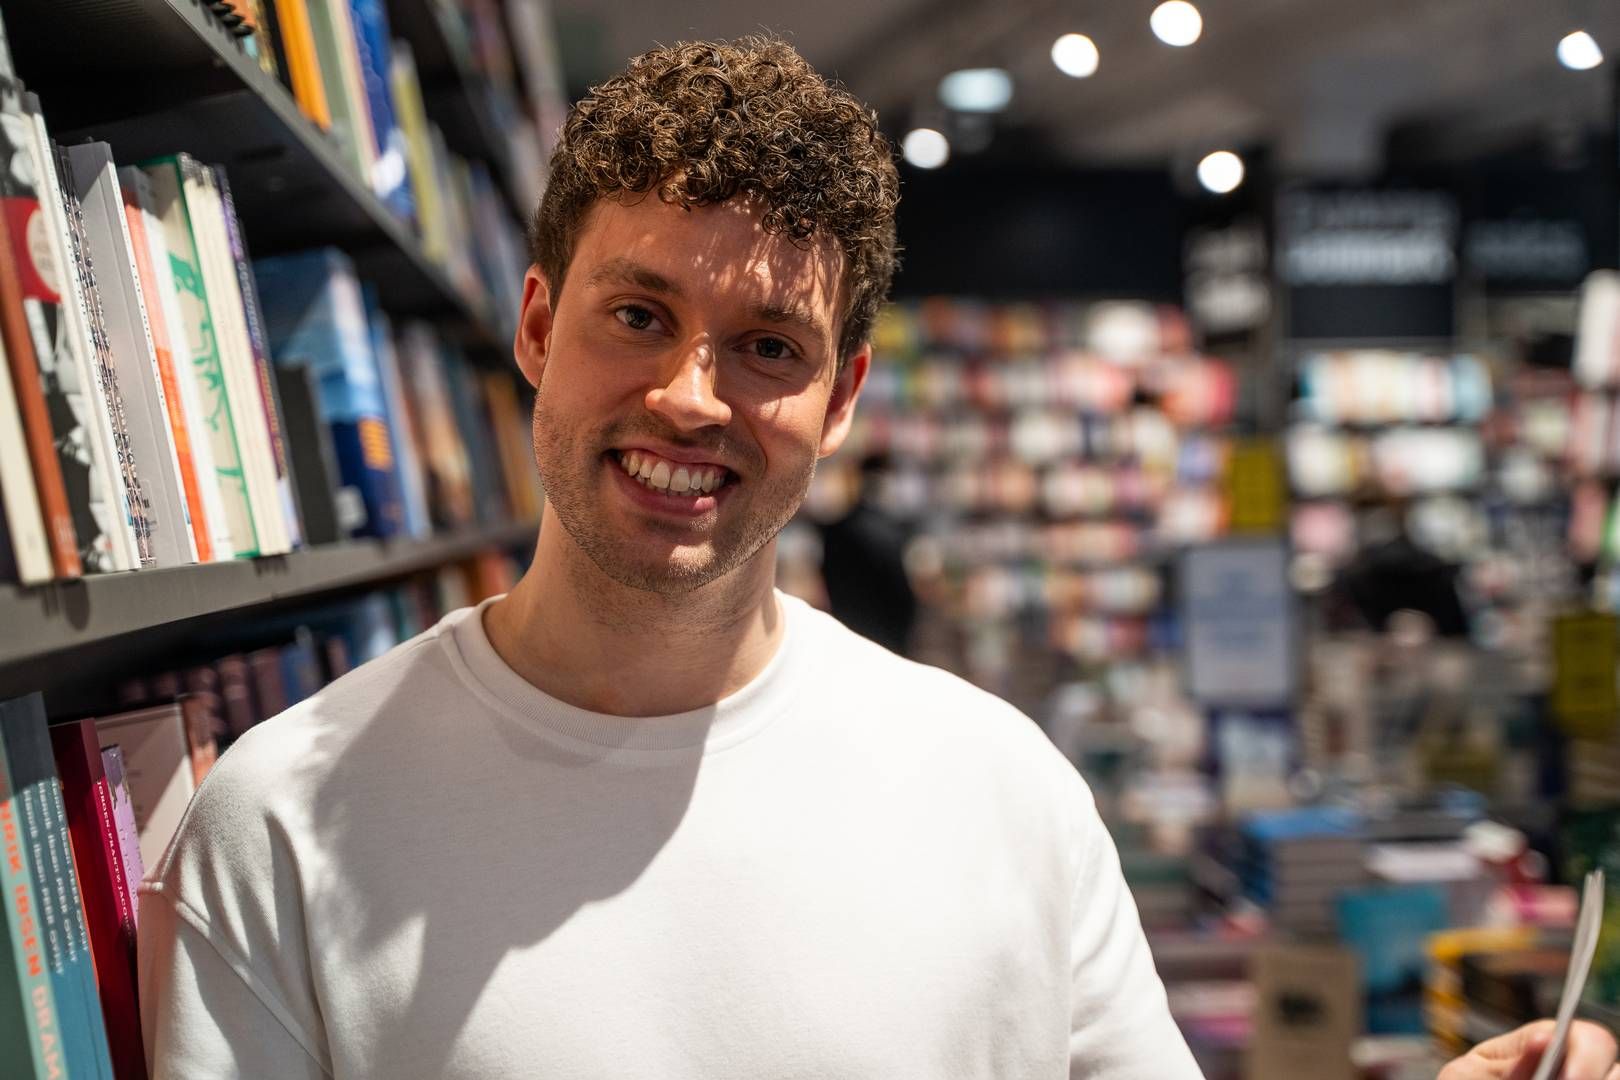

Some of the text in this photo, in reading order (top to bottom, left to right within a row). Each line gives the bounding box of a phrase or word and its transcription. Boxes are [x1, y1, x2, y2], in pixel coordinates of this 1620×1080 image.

[22, 789, 38, 838] Henrik
[33, 843, 46, 884] Ibsen
[41, 887, 55, 926] PEER
[38, 781, 52, 830] Henrik
[47, 834, 60, 873] Ibsen
[56, 877, 69, 914] PEER
[14, 884, 42, 977] IBSEN
